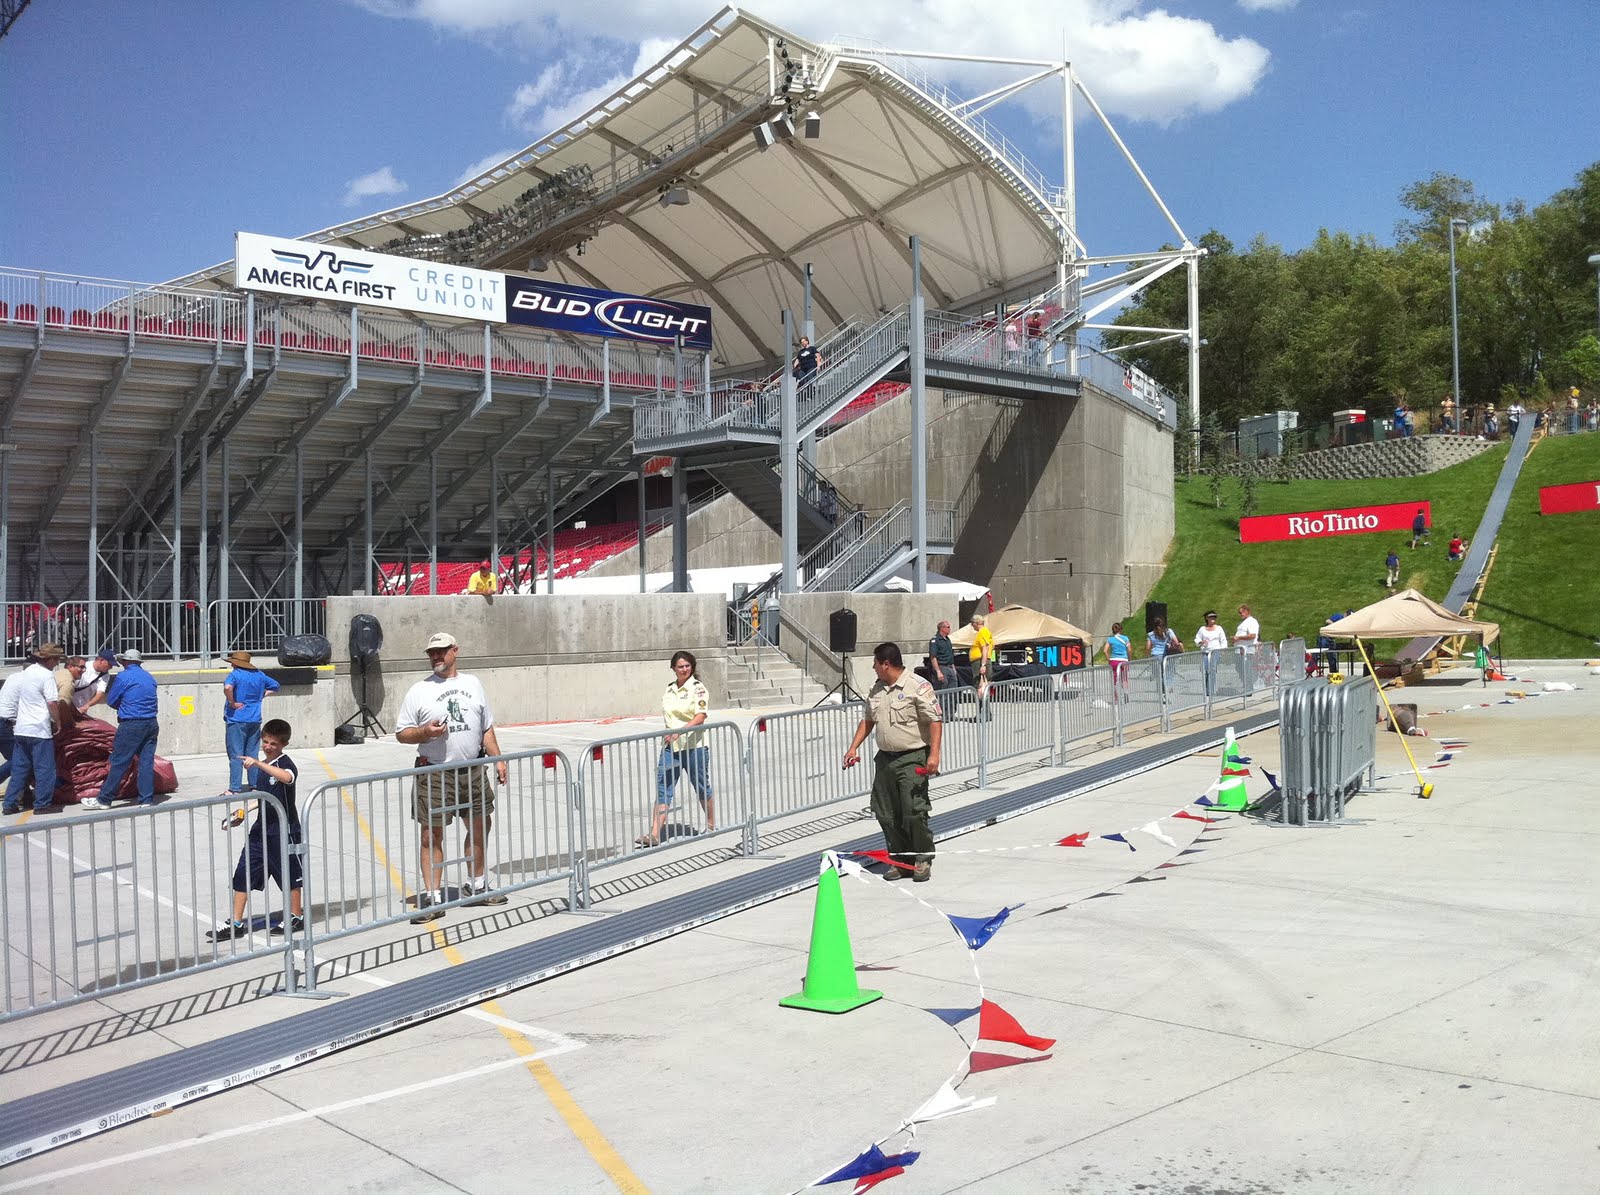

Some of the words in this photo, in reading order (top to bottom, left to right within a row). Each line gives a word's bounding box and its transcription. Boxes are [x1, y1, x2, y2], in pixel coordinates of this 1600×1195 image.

[247, 266, 338, 293] AMERICA
[342, 280, 396, 300] FIRST
[409, 268, 499, 294] CREDIT
[417, 287, 492, 311] UNION
[512, 290, 591, 316] BUD
[612, 305, 707, 333] LIGHT
[1061, 645, 1082, 666] US
[179, 695, 195, 716] 5
